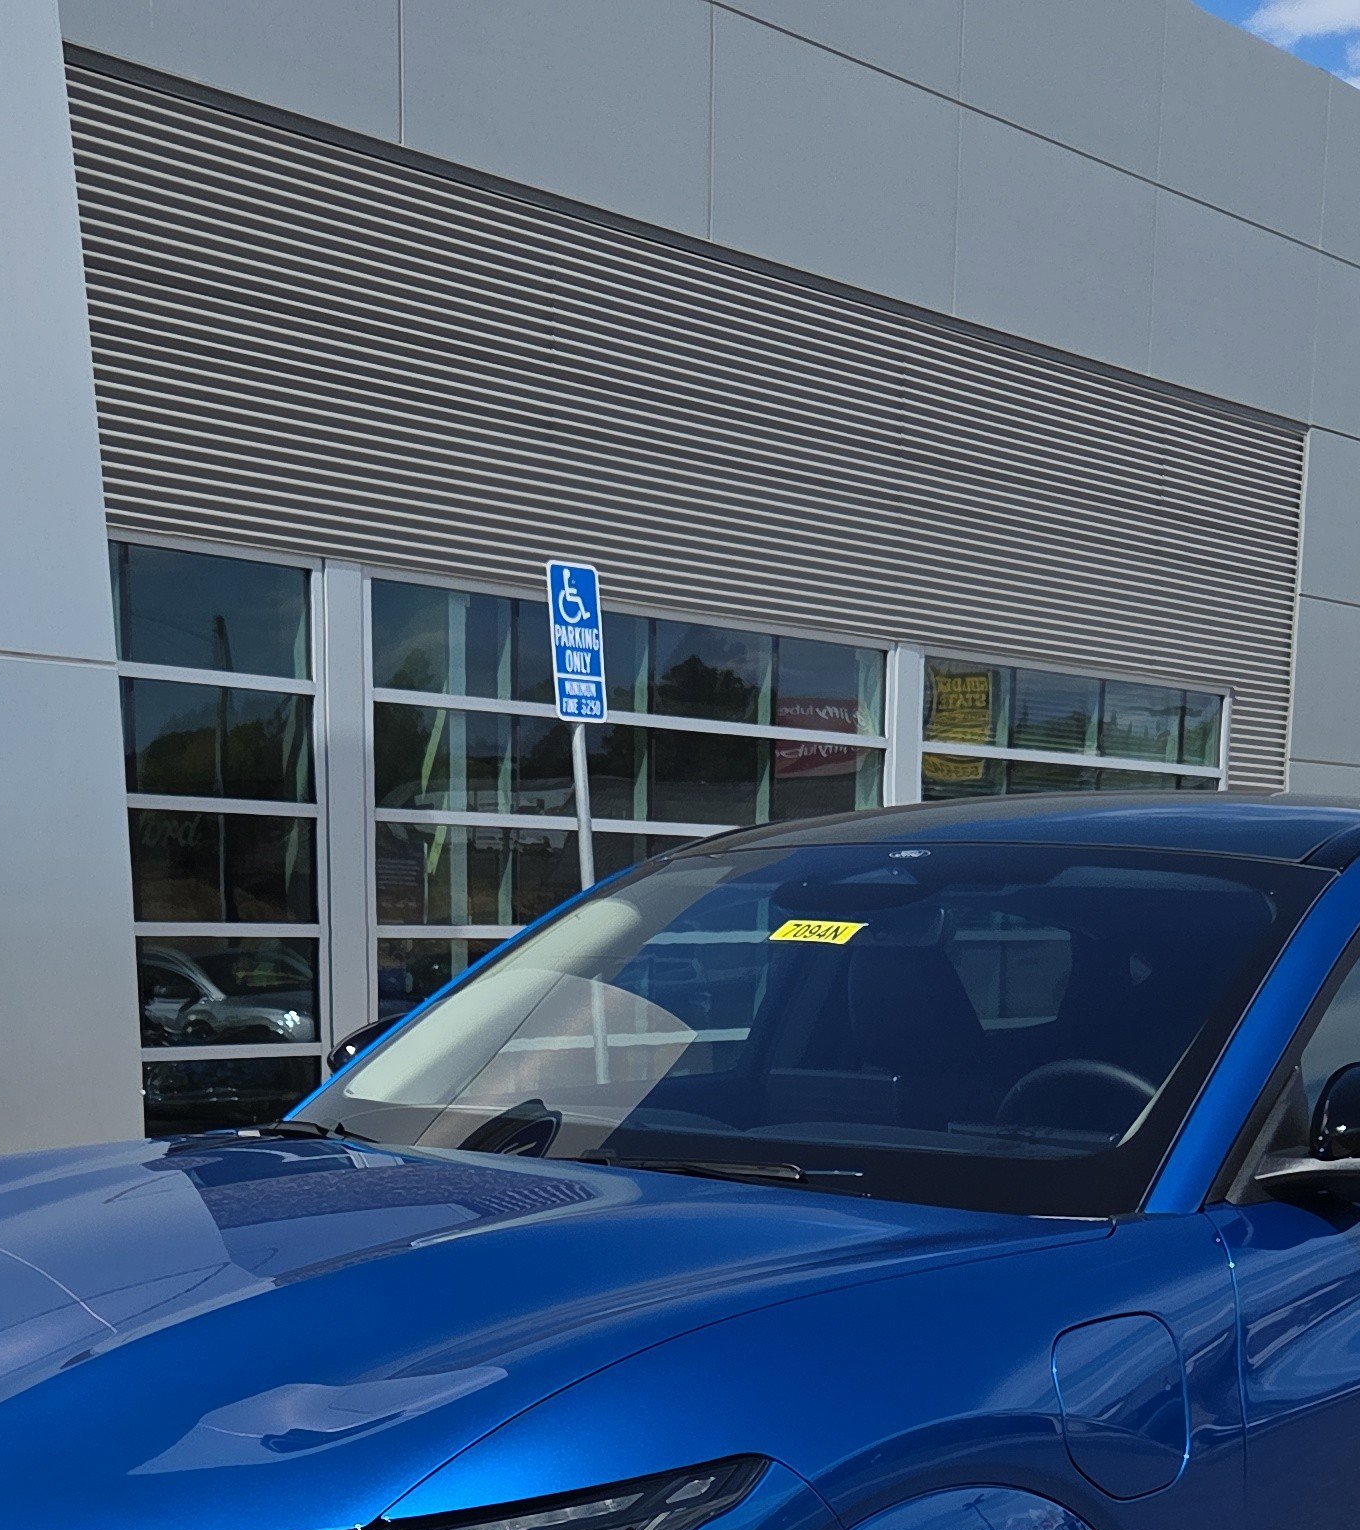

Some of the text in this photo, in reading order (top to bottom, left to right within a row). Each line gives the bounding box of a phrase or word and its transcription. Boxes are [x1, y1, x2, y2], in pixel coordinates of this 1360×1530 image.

[555, 624, 600, 651] PARKING
[566, 650, 592, 674] ONLY
[562, 697, 579, 714] FINE
[782, 923, 848, 941] 7094N
